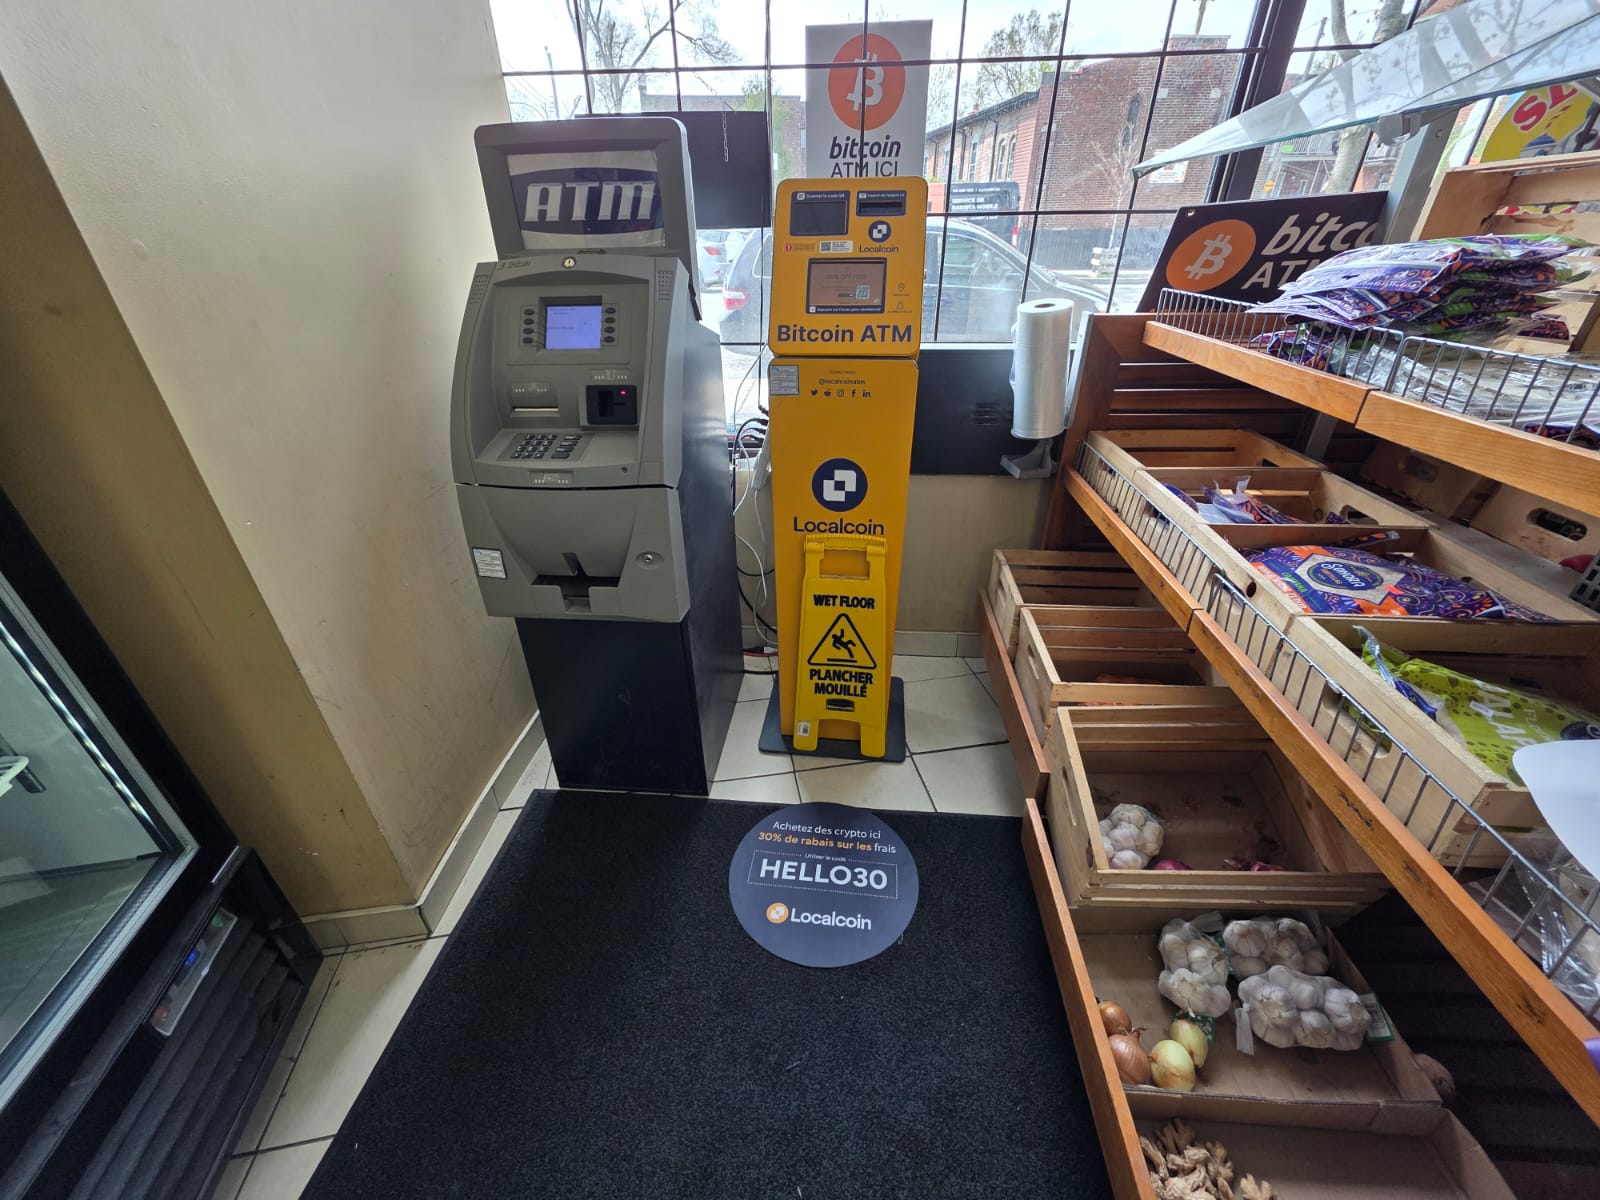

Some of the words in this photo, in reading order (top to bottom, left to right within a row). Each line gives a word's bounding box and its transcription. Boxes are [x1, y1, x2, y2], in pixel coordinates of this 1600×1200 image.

[829, 135, 901, 159] bitcoin
[831, 161, 869, 178] ATM
[875, 161, 898, 177] ICI
[524, 181, 656, 222] ATM
[859, 245, 899, 253] Localcoin
[1241, 260, 1319, 290] AT
[777, 324, 854, 343] Bitcoin
[860, 324, 912, 343] ATM
[793, 516, 885, 535] Localcoin
[813, 594, 838, 607] WET
[839, 595, 876, 610] FLOOR
[809, 669, 873, 685] PLANCHER
[814, 682, 868, 698] MOUILLÉ
[772, 821, 812, 833] Achetez
[814, 825, 832, 836] des
[834, 829, 867, 839] crypto
[869, 830, 881, 840] ici
[758, 832, 782, 843] 30%
[784, 835, 799, 844] de
[801, 836, 834, 848] rabais
[837, 841, 854, 850] sur
[856, 842, 872, 852] les
[874, 842, 897, 854] frais
[759, 858, 888, 890] HELLO30
[790, 908, 872, 930] Localcoin
